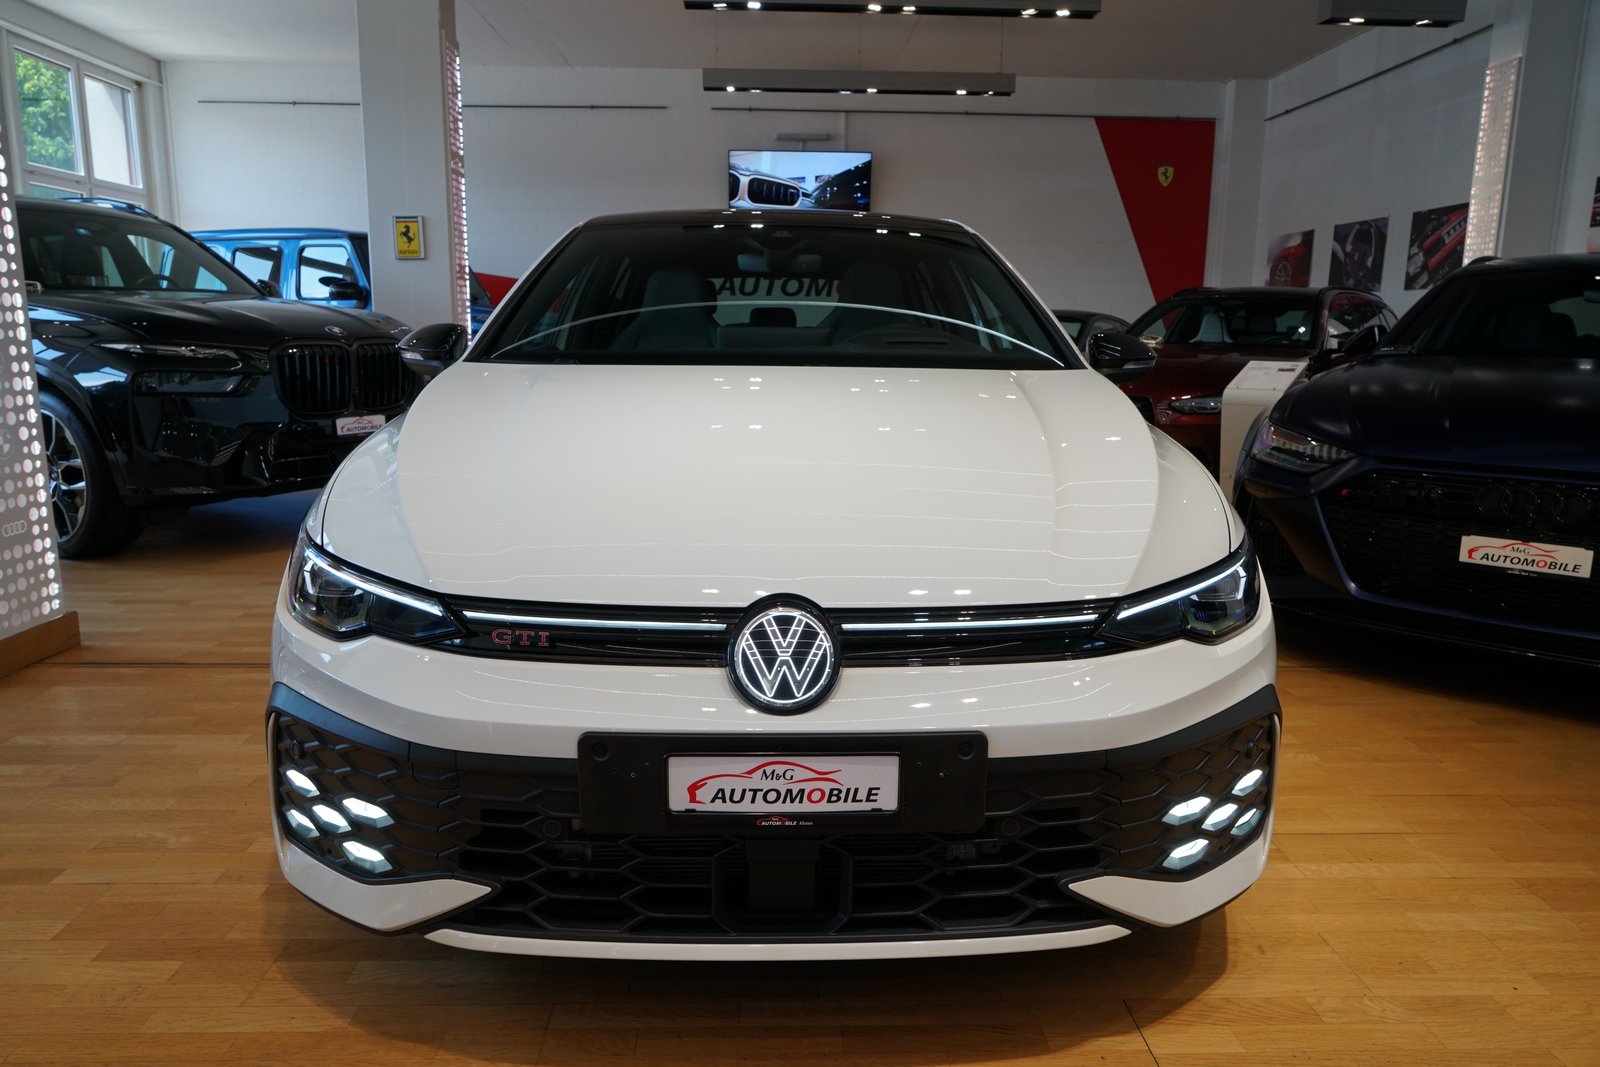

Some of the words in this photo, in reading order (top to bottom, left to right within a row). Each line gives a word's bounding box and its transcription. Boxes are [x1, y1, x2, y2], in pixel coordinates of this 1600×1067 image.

[1480, 552, 1583, 574] AUTOMOBILE
[491, 629, 550, 647] GTI
[760, 768, 796, 781] M&G
[709, 786, 881, 805] AUTOMOBILE
